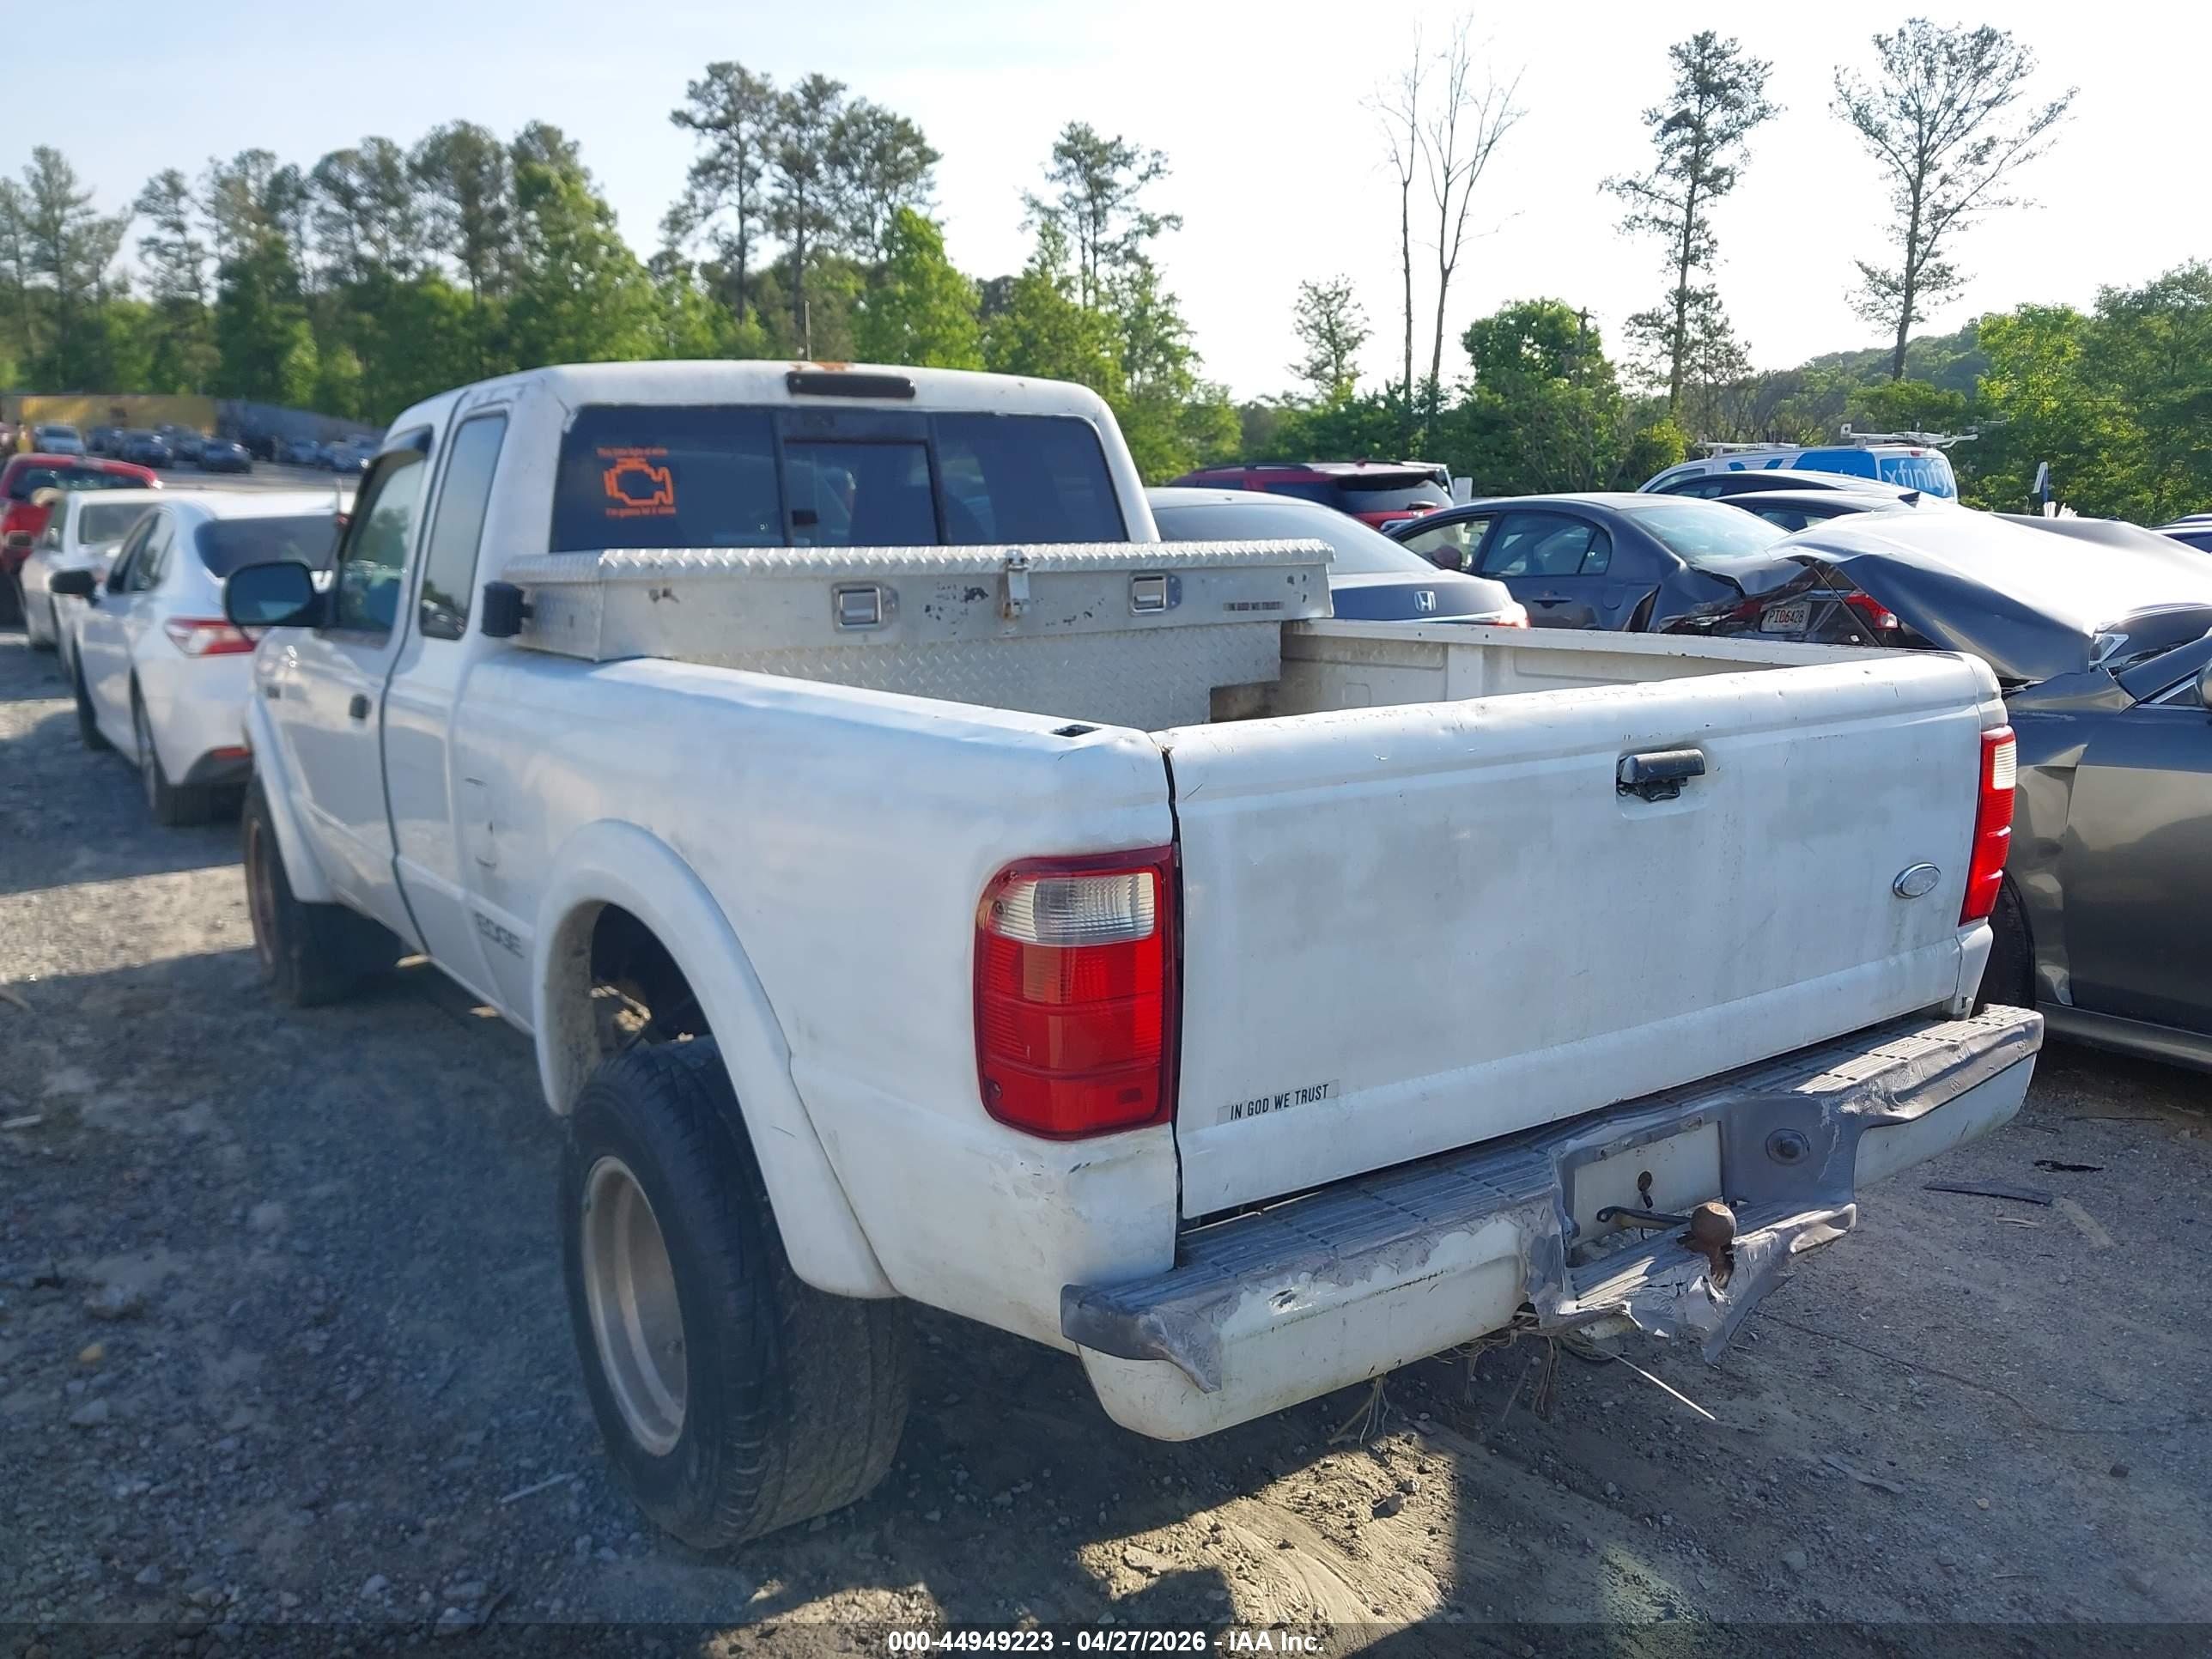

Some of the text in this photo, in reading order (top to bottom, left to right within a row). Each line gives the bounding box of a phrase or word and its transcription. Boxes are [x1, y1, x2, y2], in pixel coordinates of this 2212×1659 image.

[1884, 459, 1954, 496] xfinity
[1231, 1084, 1328, 1120] IN GOD WE TRUST
